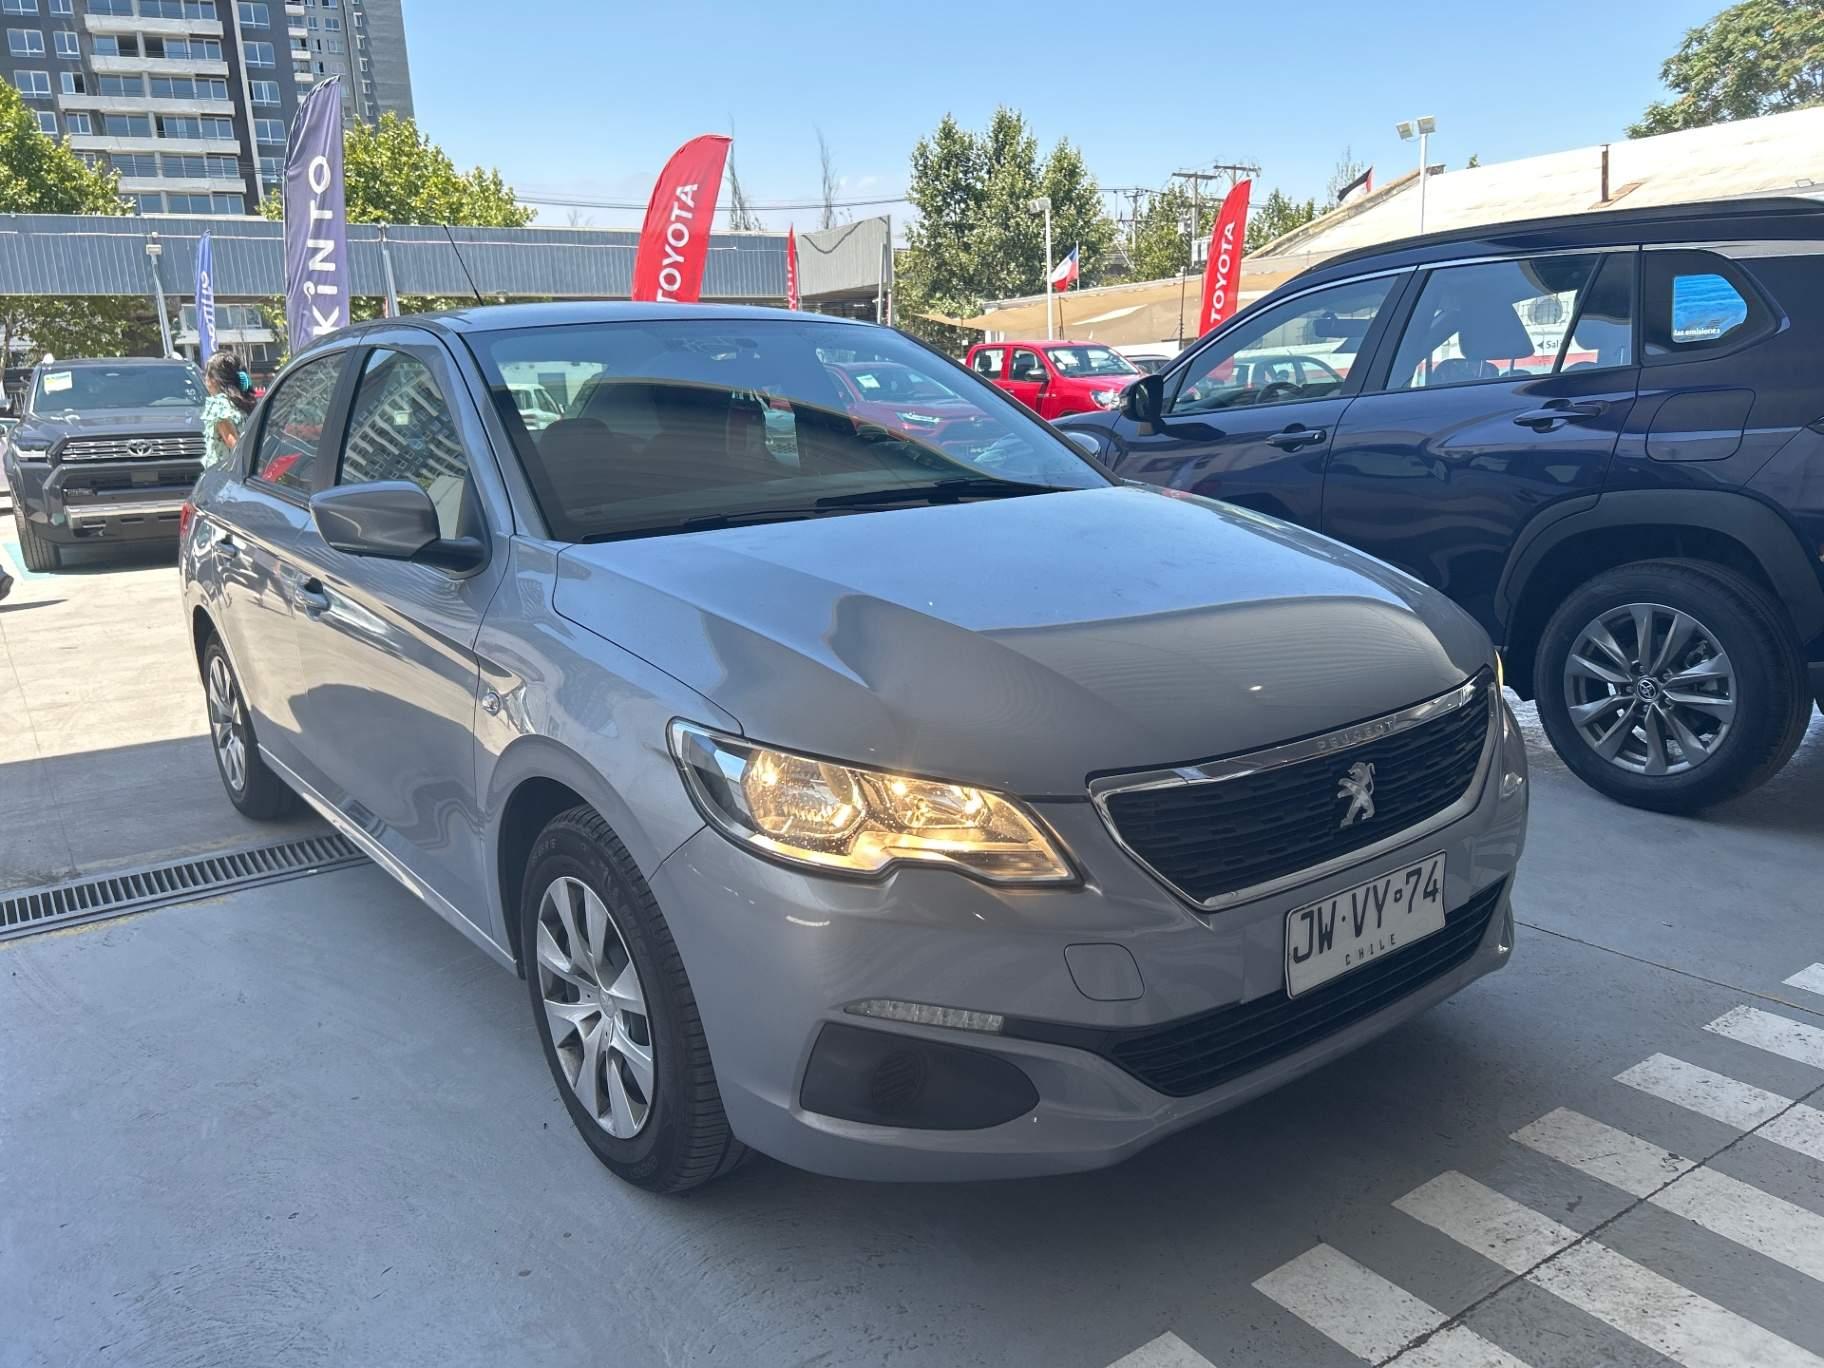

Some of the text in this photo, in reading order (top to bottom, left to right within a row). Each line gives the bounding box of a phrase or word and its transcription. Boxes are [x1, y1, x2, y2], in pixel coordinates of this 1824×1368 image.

[656, 183, 698, 303] TOYOTA
[1210, 221, 1236, 324] TOYOTA
[1345, 933, 1397, 967] CHILE
